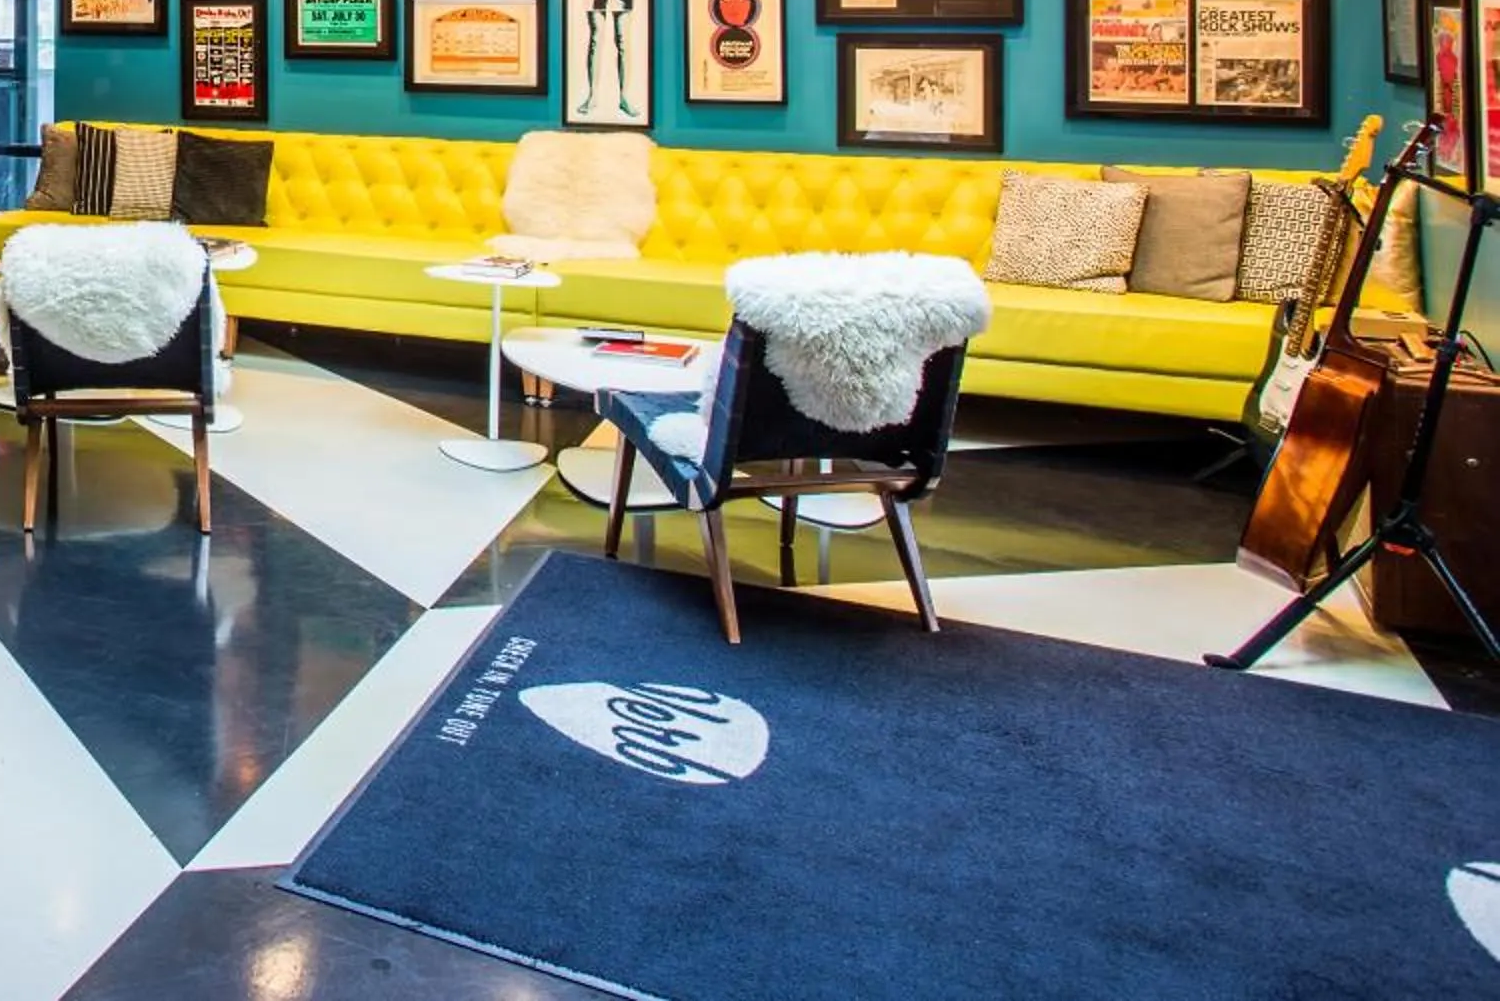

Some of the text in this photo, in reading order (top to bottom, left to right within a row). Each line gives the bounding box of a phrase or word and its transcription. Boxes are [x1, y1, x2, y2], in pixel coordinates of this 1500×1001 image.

[1200, 10, 1277, 22] GREATEST
[1200, 20, 1301, 33] ROCK SHOWS
